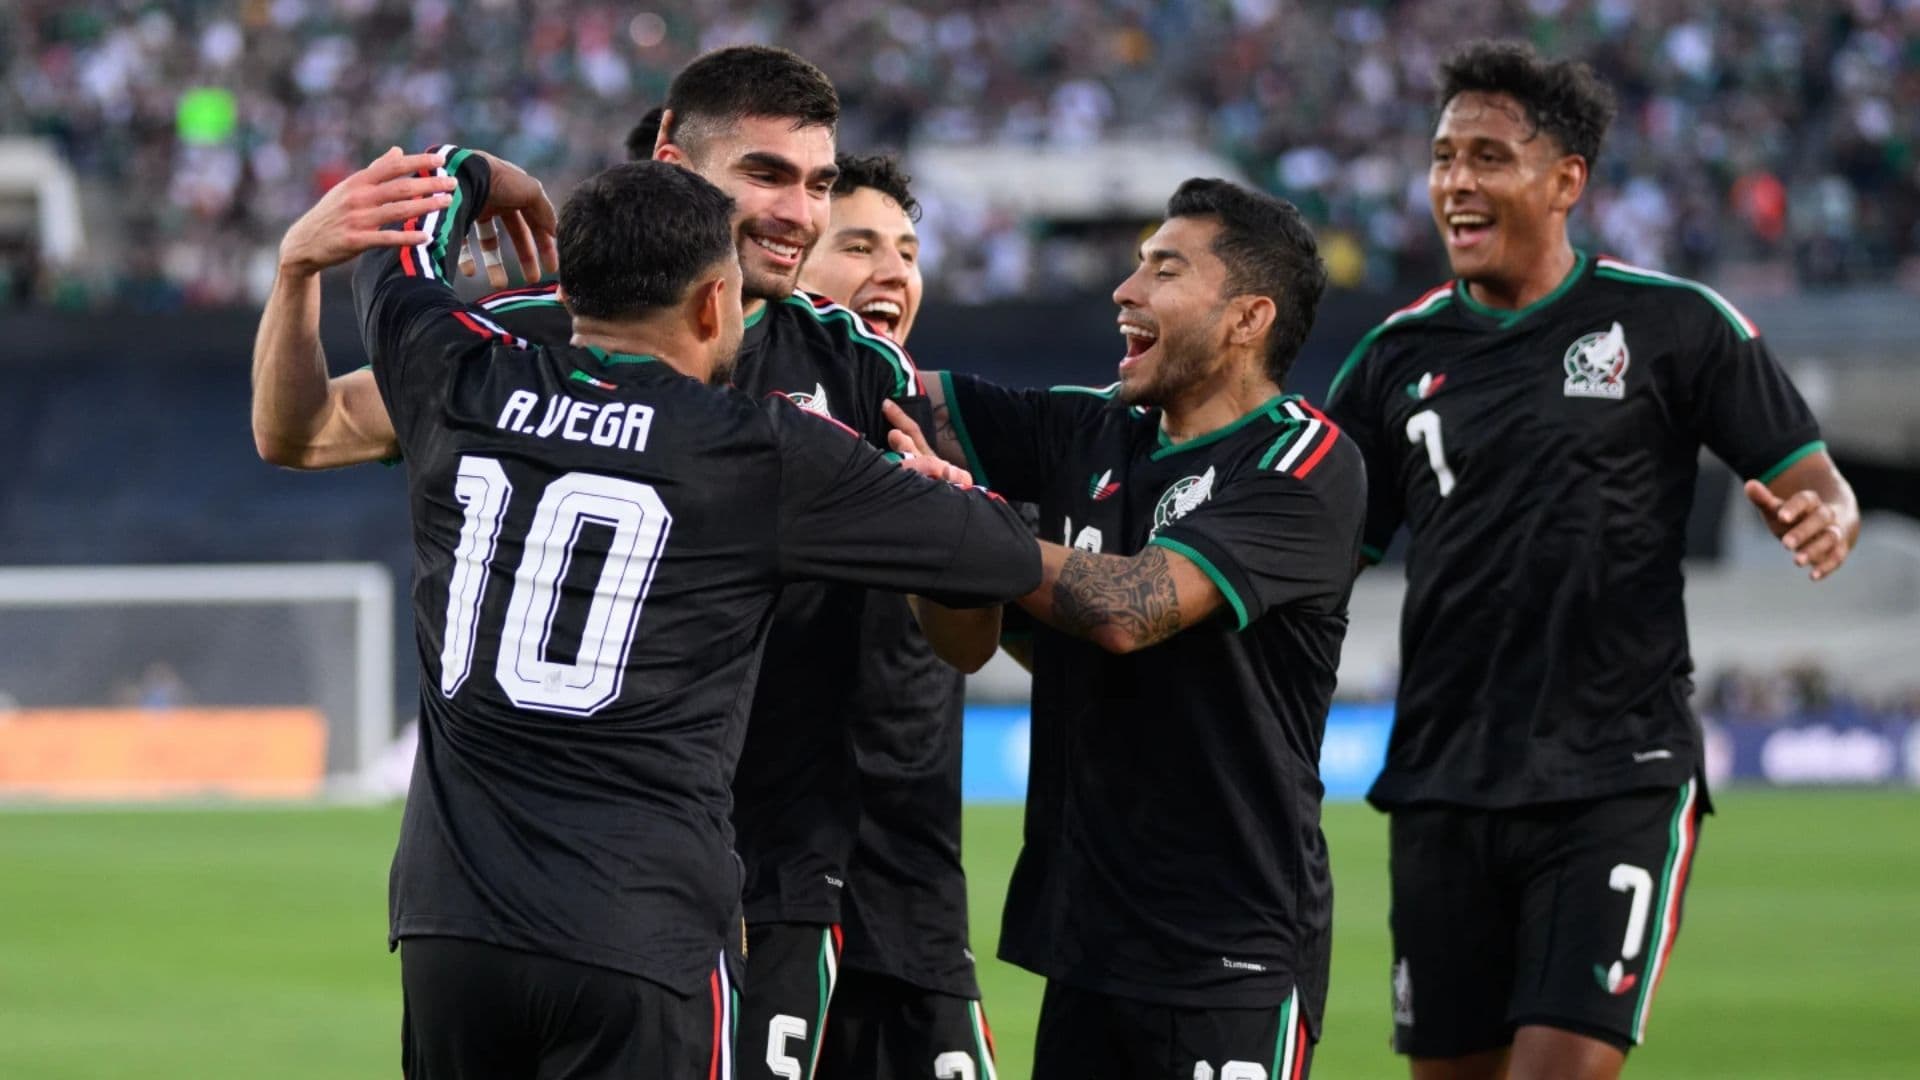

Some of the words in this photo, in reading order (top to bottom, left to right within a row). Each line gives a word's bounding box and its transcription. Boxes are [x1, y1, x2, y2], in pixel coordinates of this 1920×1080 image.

[497, 390, 654, 451] A.VEGA
[1406, 409, 1456, 498] 7
[441, 455, 673, 717] 10
[1608, 863, 1653, 960] 7
[766, 1014, 807, 1080] 5
